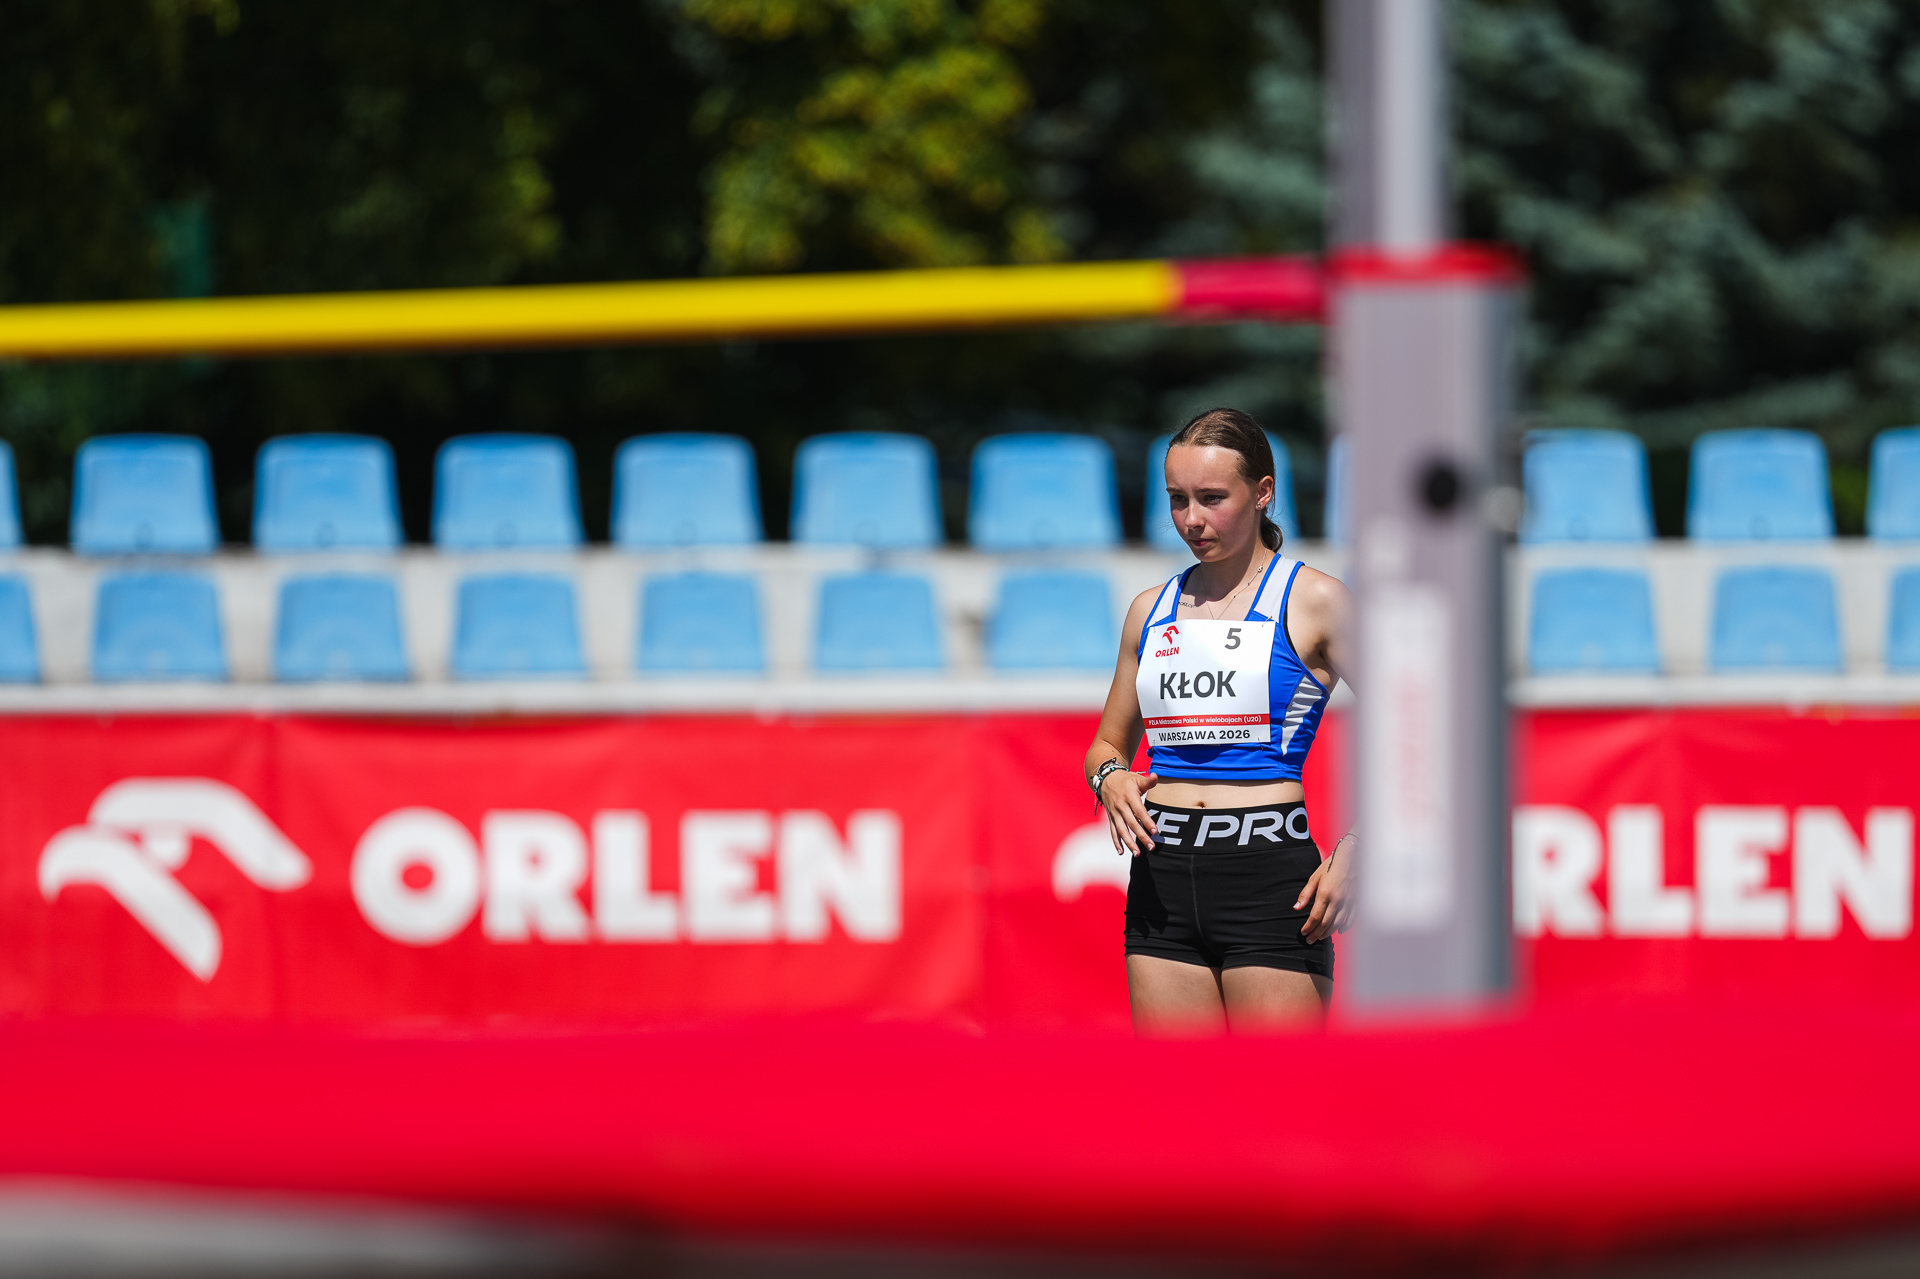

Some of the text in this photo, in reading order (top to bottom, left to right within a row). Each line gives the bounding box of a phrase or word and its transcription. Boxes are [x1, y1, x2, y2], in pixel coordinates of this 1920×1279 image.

[1224, 627, 1242, 650] 5
[1155, 646, 1180, 658] ORLEN
[1159, 670, 1237, 700] KŁOK
[1205, 716, 1243, 725] wielobojach
[1243, 714, 1262, 724] (U20)
[1158, 729, 1251, 742] WARSZAWA 2026
[1194, 806, 1310, 847] PRO
[350, 806, 903, 948] ORLEN
[1511, 803, 1914, 941] RLEN
